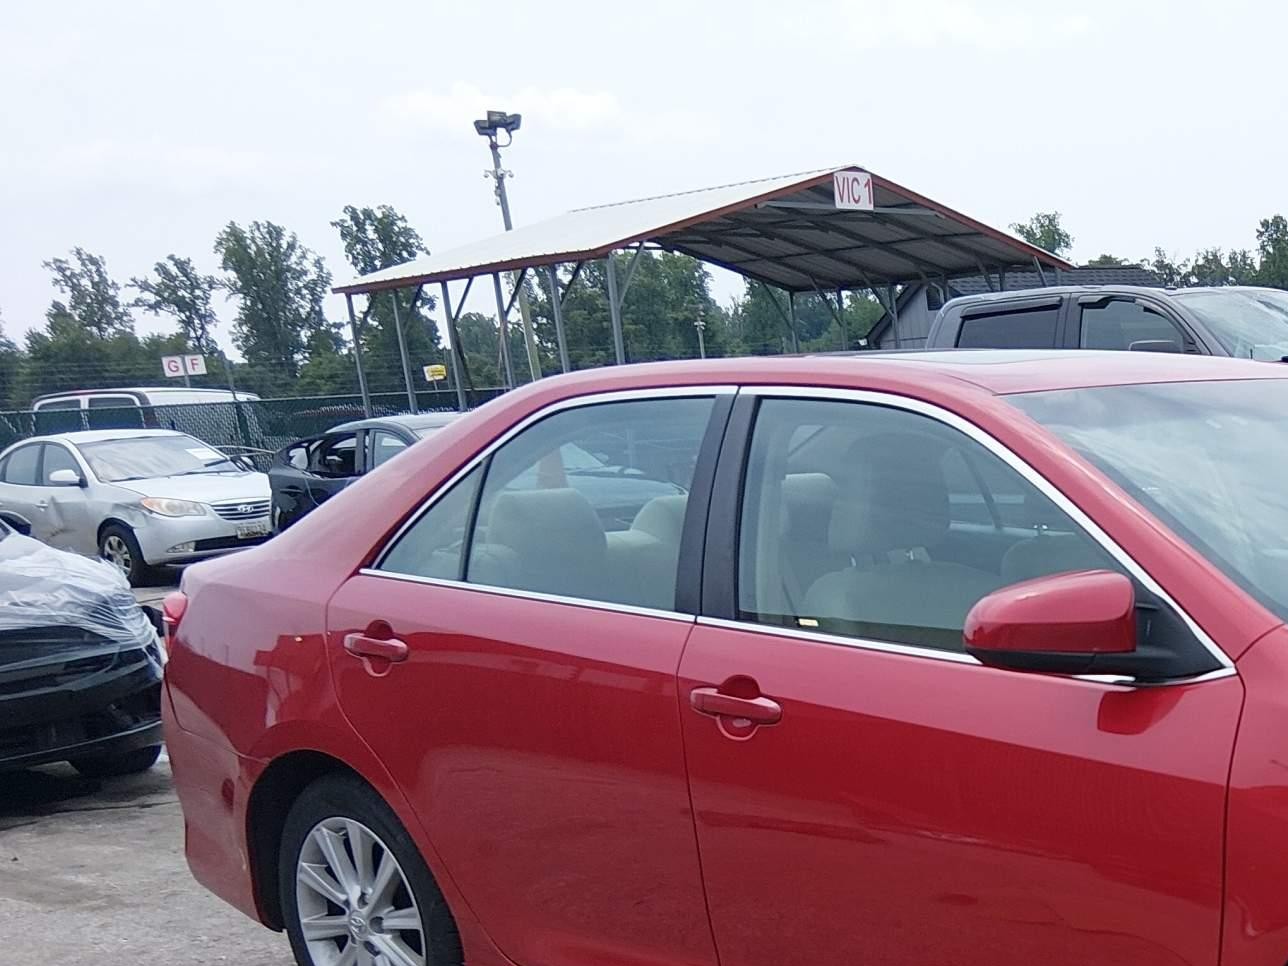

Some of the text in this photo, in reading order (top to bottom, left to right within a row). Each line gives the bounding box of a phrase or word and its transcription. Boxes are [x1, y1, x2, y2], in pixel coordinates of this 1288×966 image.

[835, 175, 872, 205] VIC 1
[167, 358, 200, 373] G F
